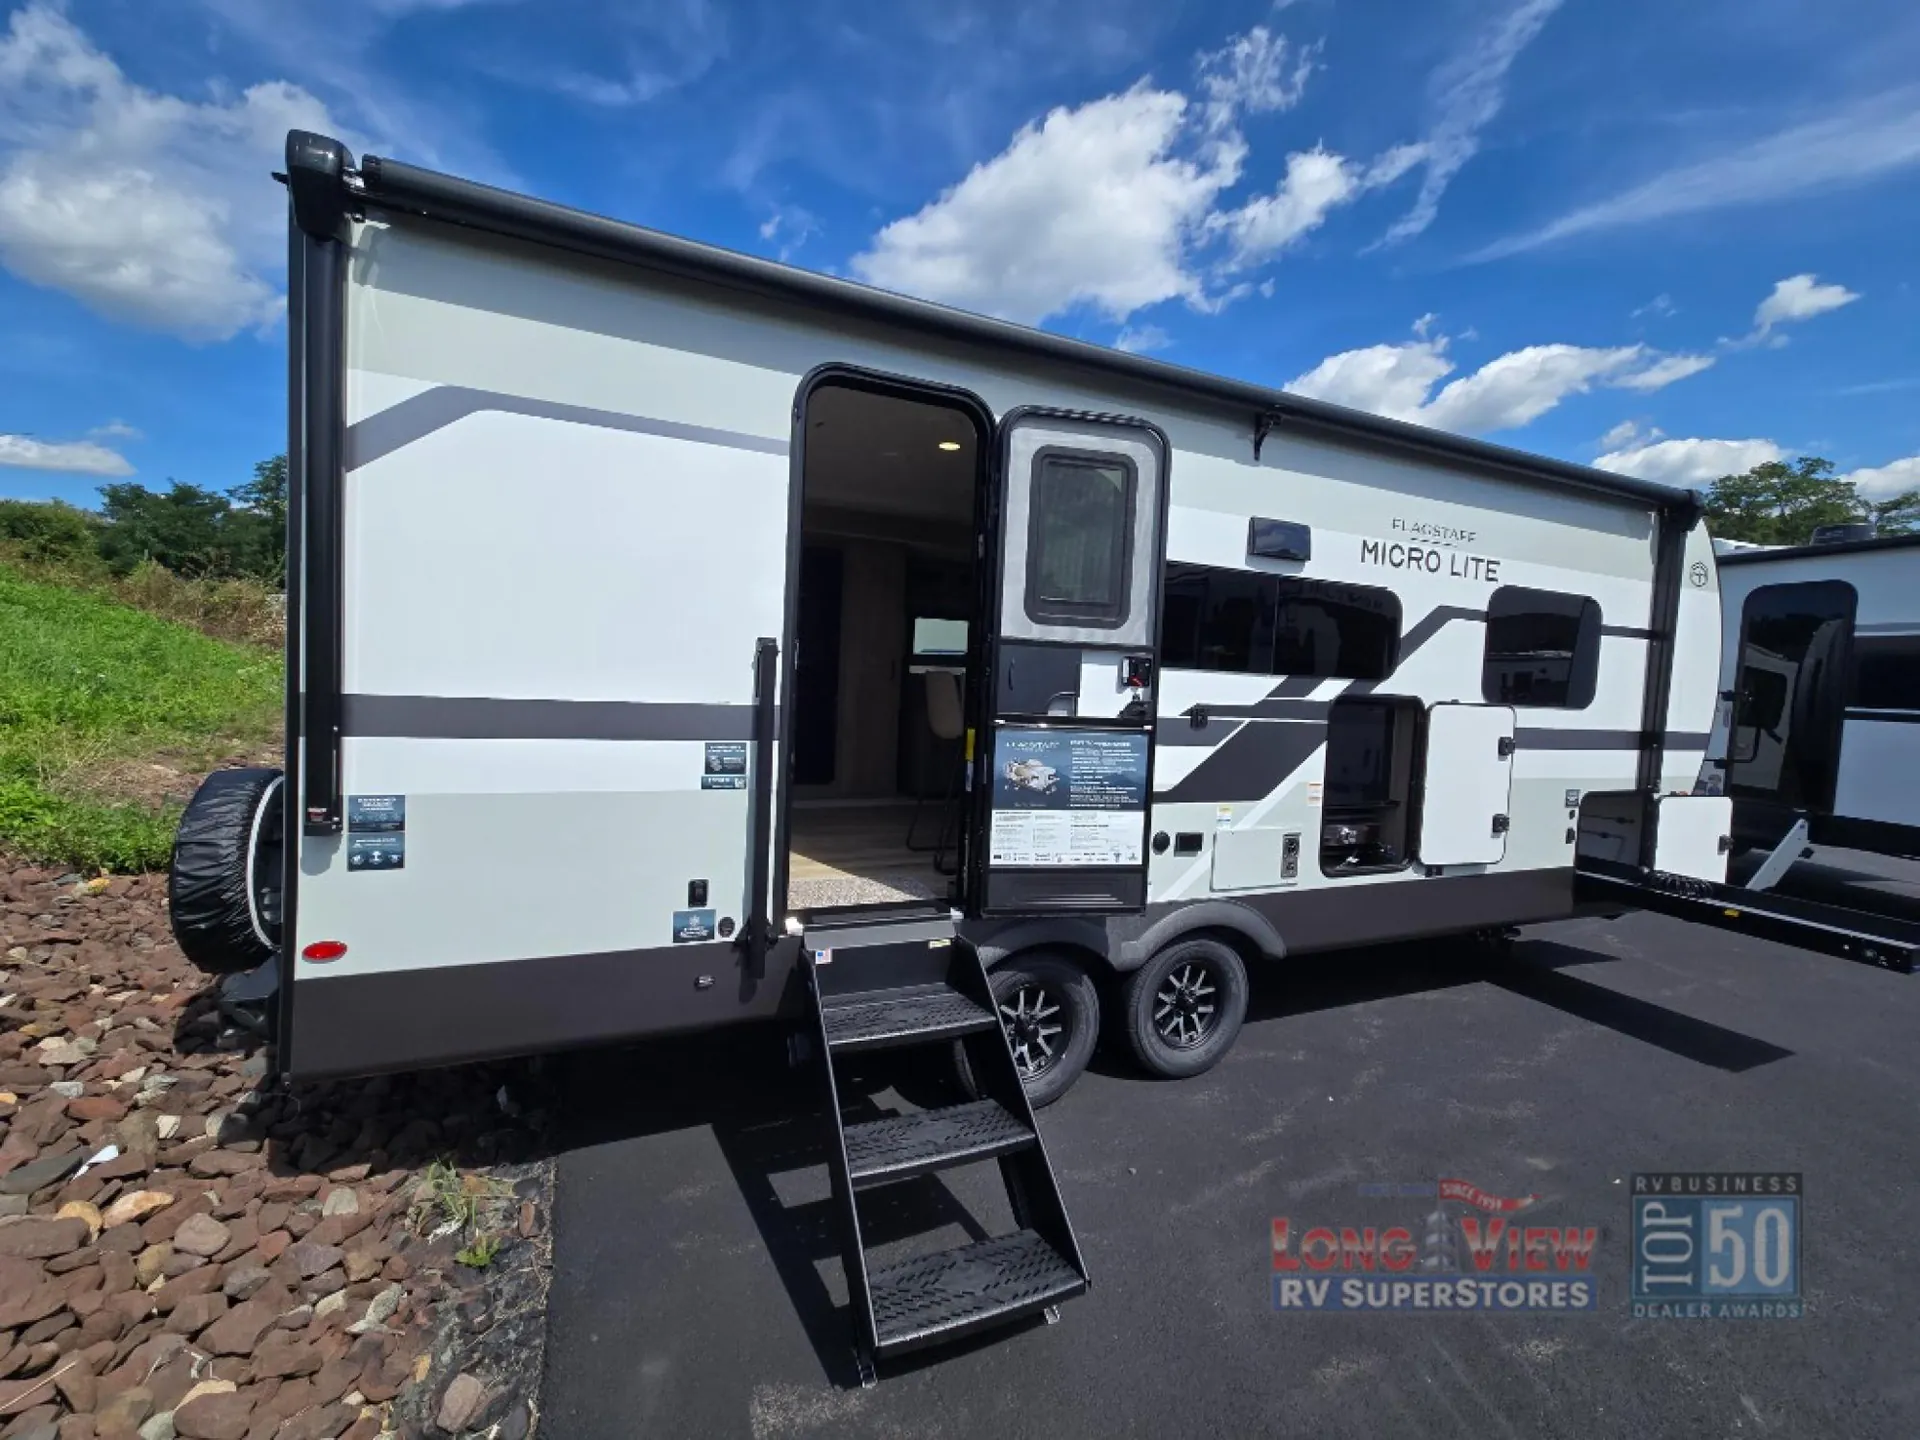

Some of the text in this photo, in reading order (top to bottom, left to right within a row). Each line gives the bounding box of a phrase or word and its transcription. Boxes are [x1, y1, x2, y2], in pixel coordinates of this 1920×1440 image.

[1392, 518, 1477, 542] FLAGSTAFF
[1360, 539, 1501, 582] MICRO LITE
